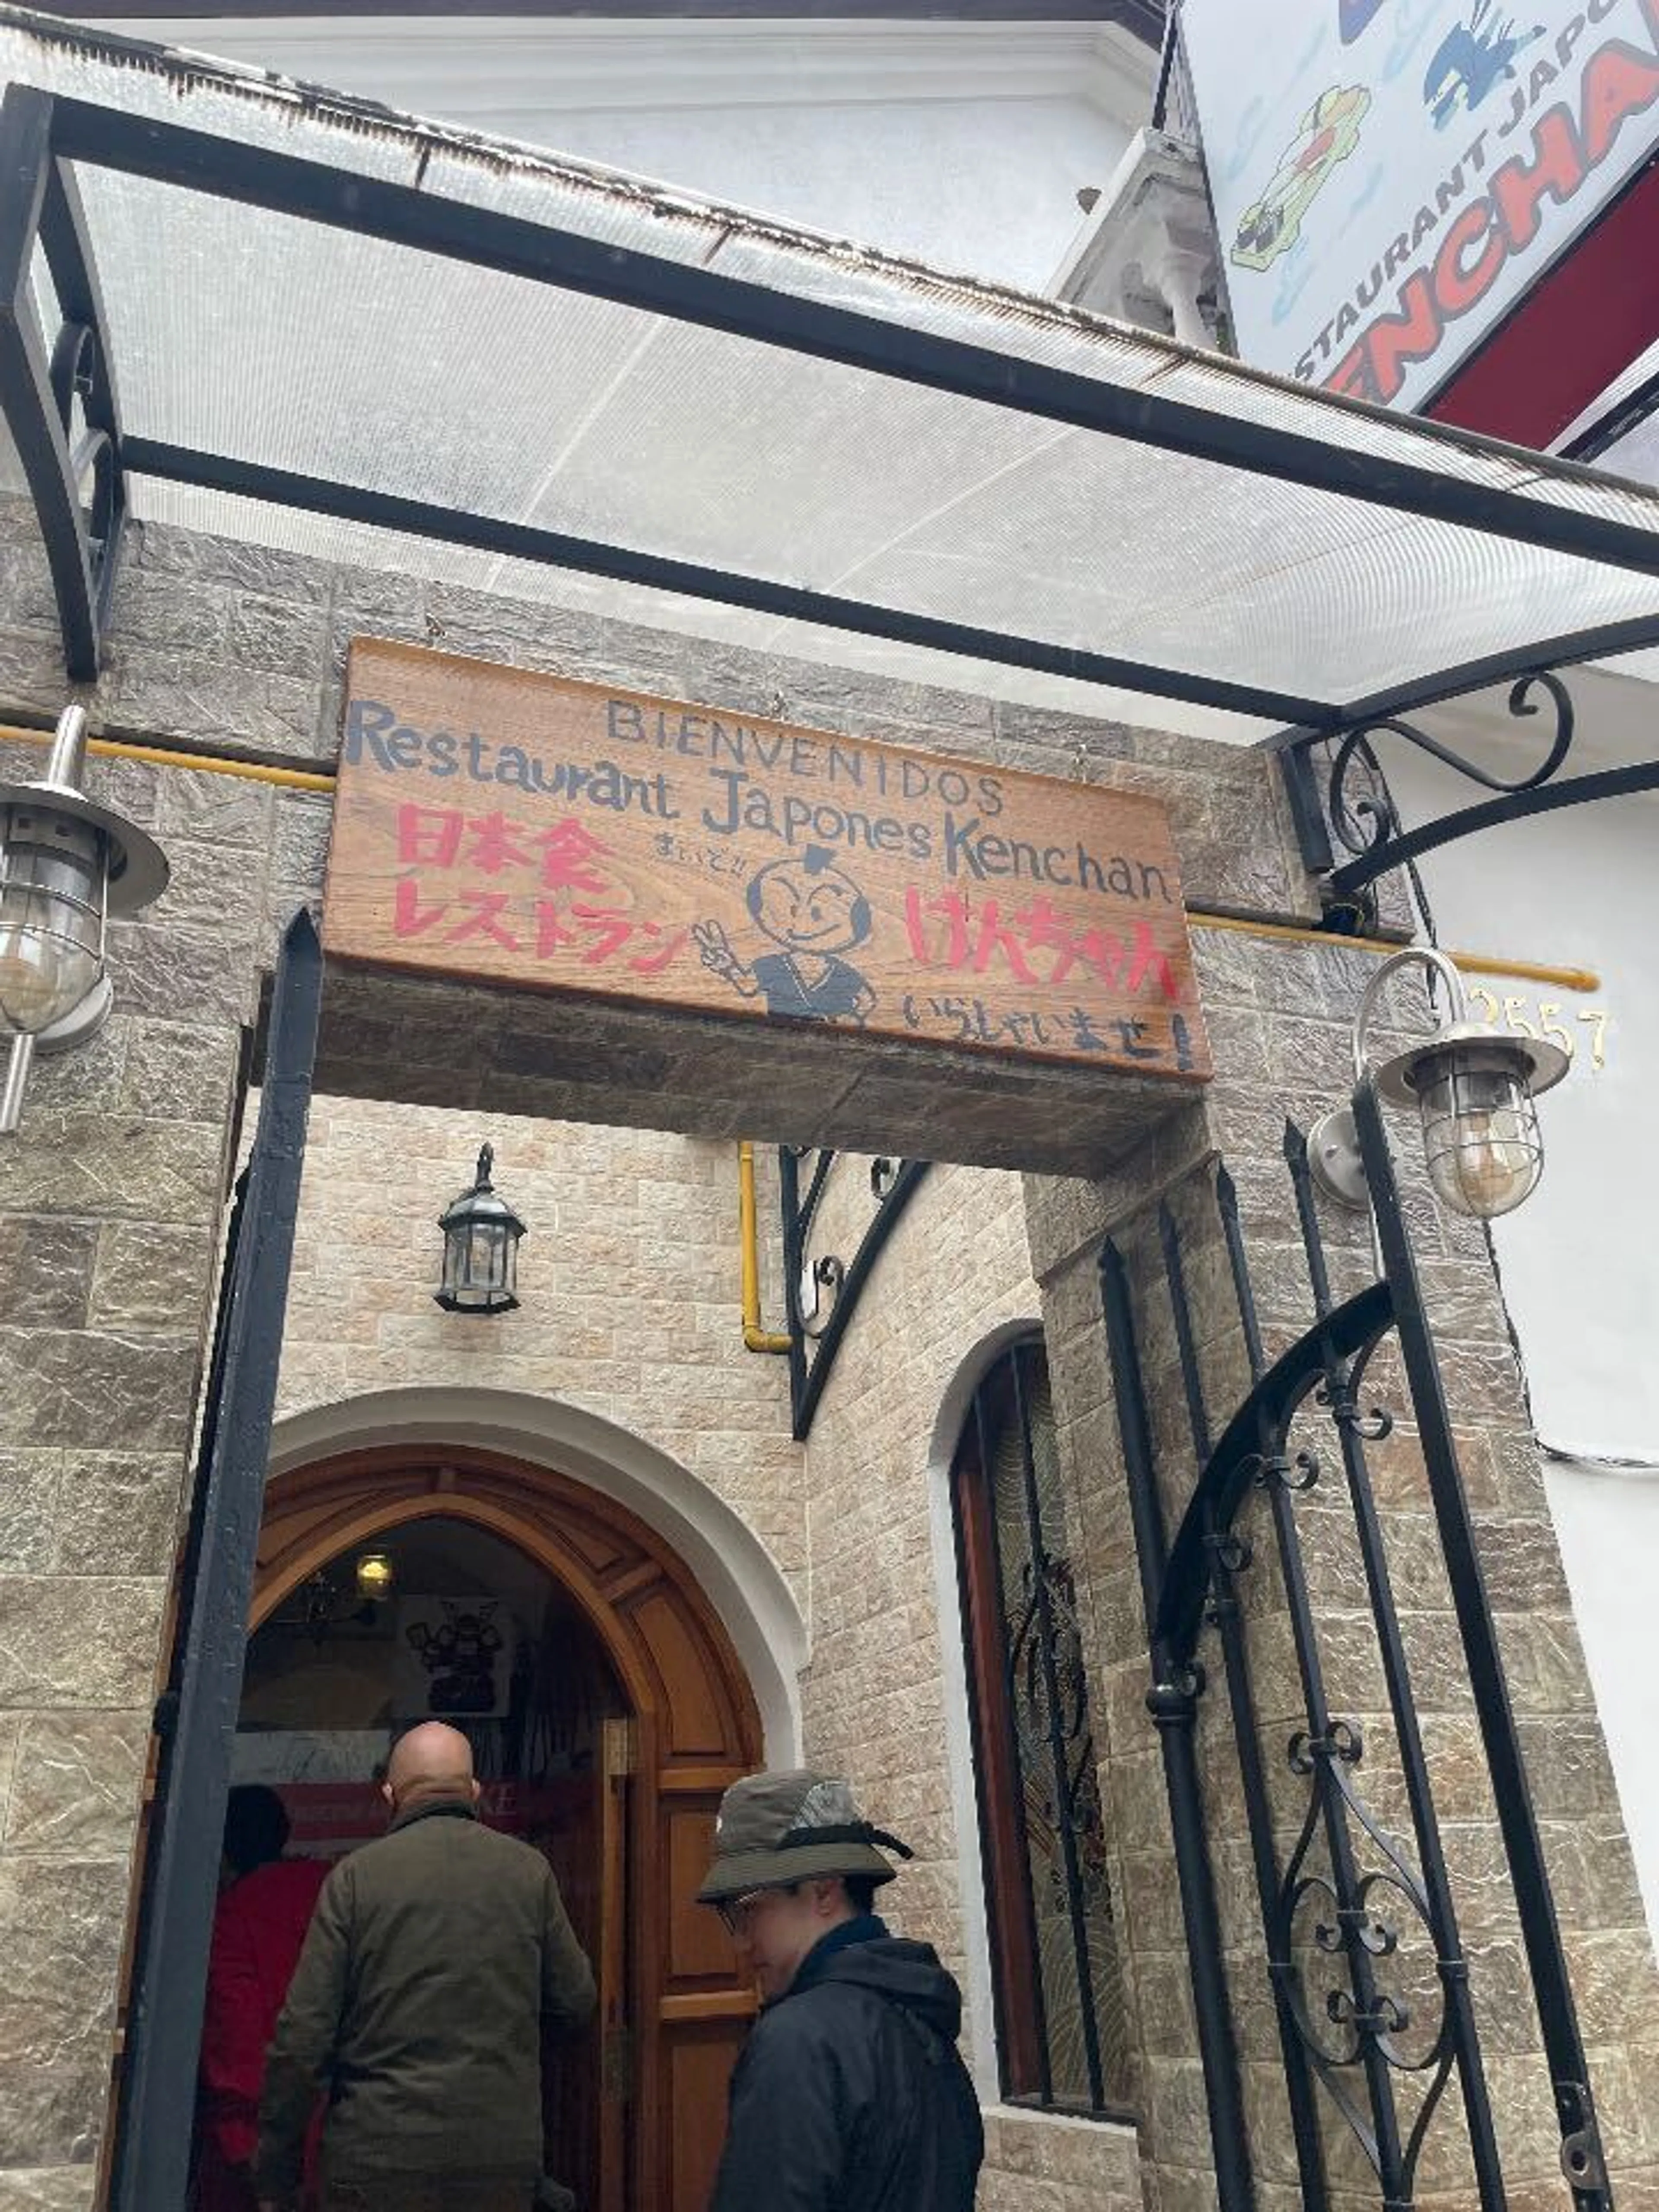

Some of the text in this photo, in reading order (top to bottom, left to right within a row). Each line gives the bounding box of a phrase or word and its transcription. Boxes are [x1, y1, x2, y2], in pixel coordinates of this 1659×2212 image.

[1294, 129, 1488, 383] STAURANT
[346, 700, 1172, 904] Restaurant Japones Kenchan
[607, 700, 1004, 817] BIENVENIDOS
[397, 802, 617, 894] 日本食
[393, 880, 688, 974] レストラン
[906, 886, 1180, 1004] けんちゃん
